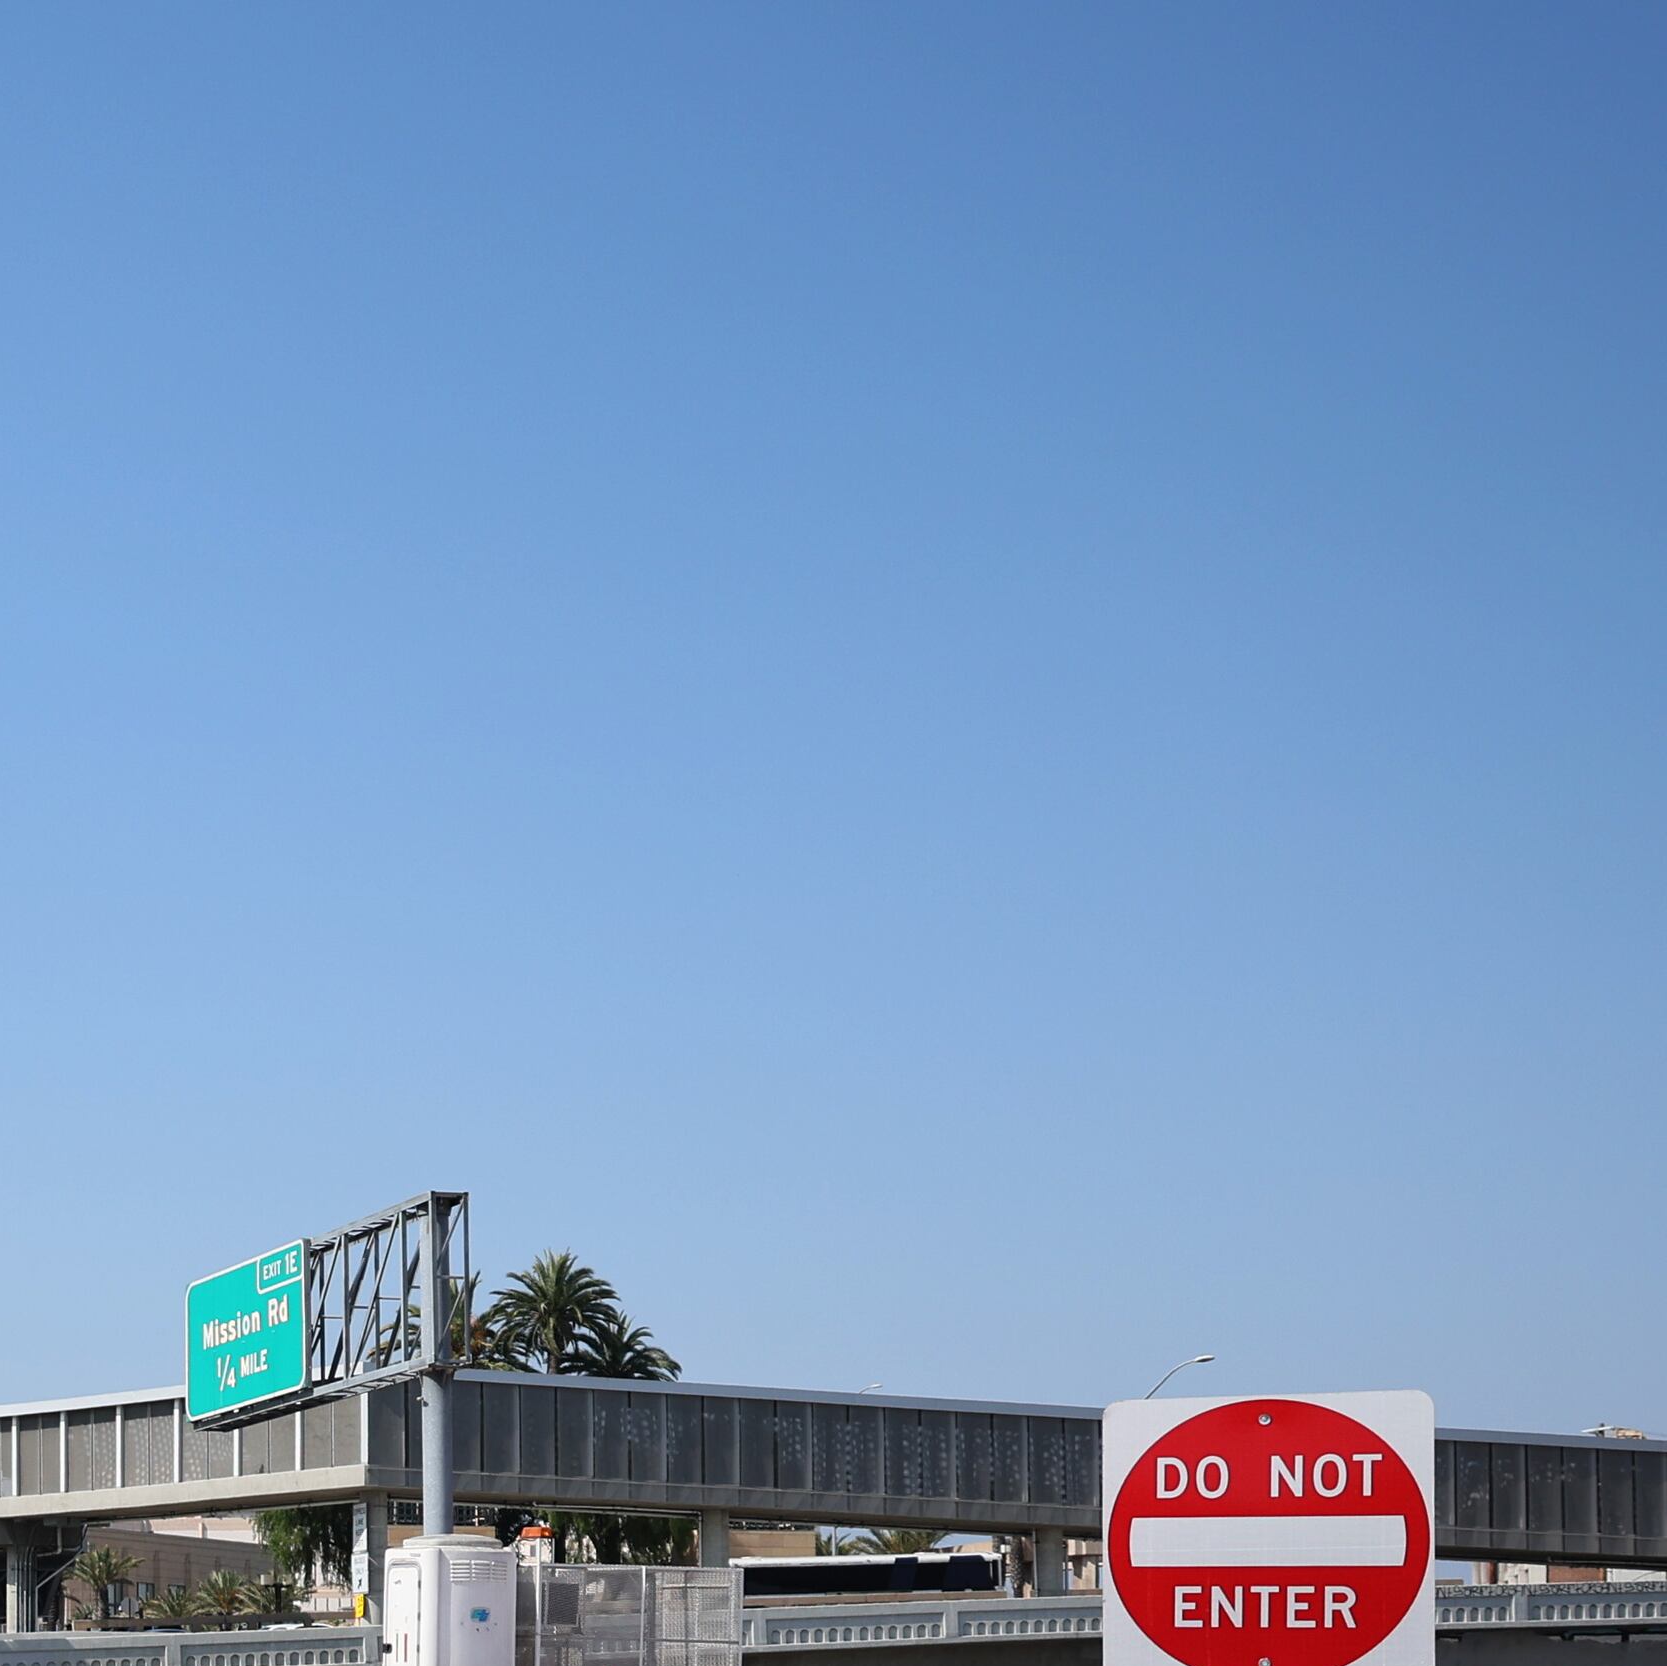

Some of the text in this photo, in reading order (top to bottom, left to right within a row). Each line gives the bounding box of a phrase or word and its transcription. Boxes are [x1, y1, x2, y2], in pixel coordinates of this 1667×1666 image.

[263, 1250, 298, 1280] EXIT 1E
[203, 1294, 289, 1350] Mission Rd
[240, 1348, 268, 1378] MILE
[1156, 1453, 1383, 1499] DO NOT
[1174, 1585, 1357, 1628] ENTER
